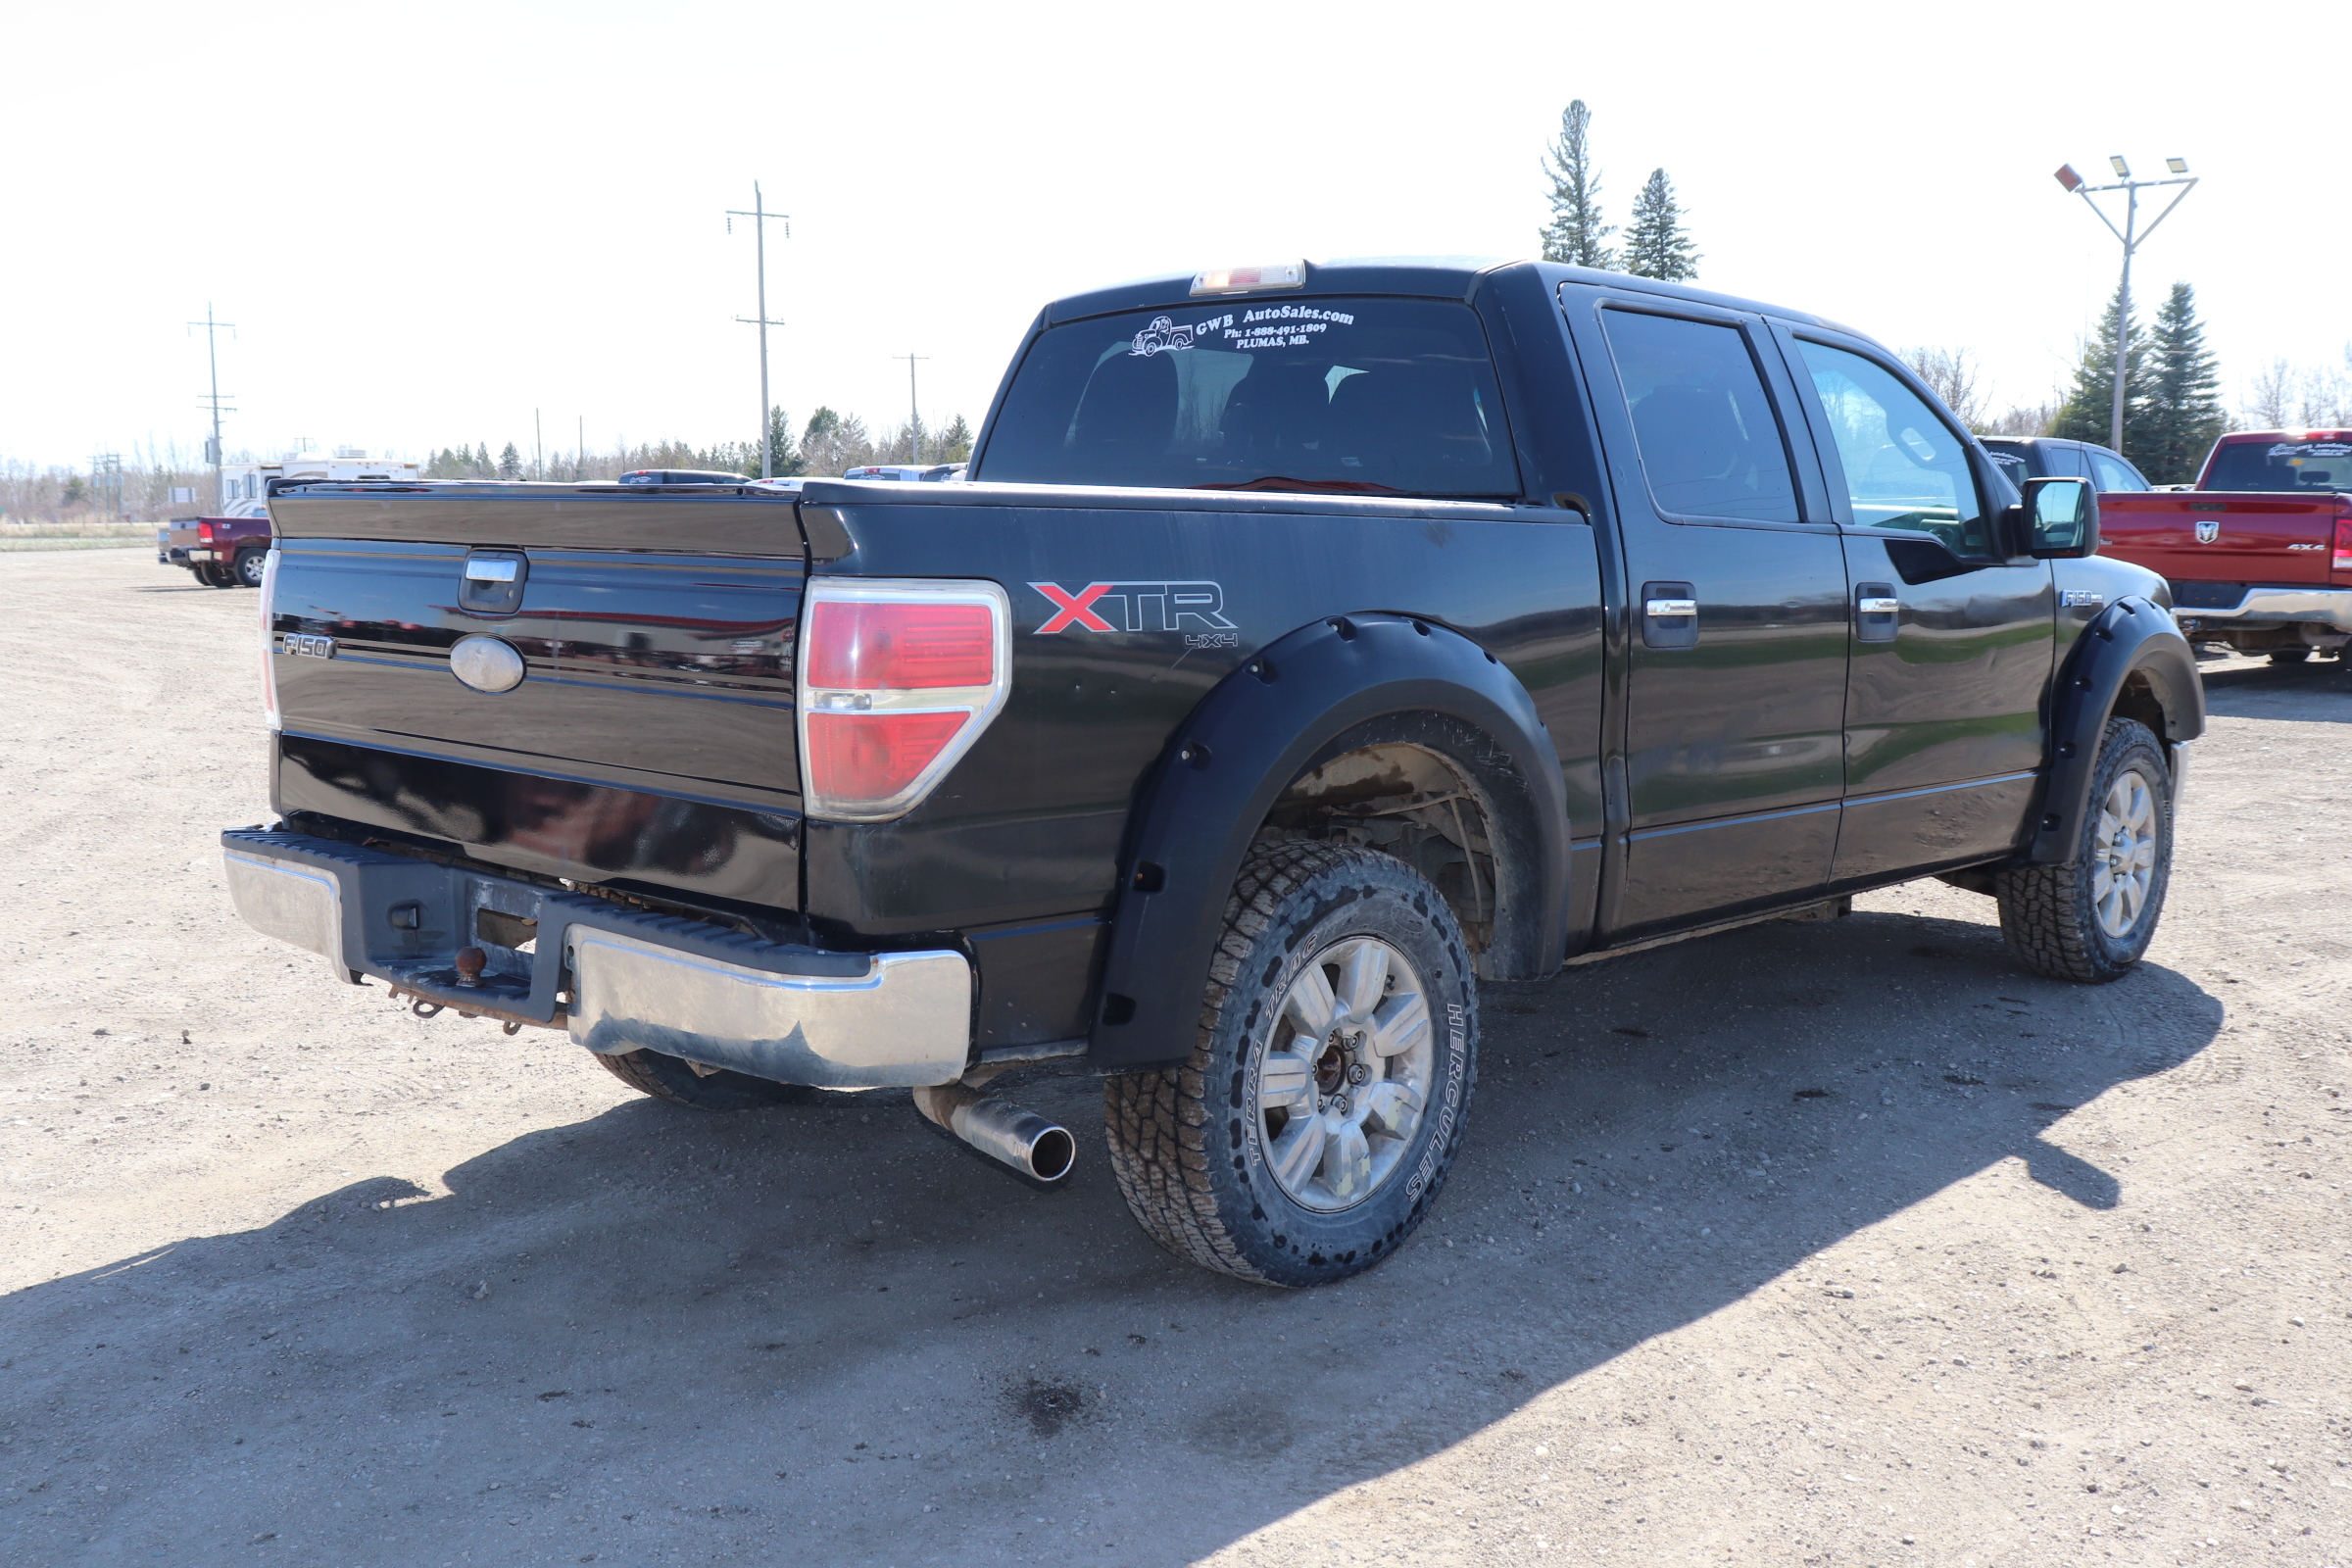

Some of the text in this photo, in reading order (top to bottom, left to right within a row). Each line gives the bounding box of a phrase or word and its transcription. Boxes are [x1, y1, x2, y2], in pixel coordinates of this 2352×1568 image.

[1196, 306, 1354, 336] GWB AutoSales.com
[1224, 323, 1327, 339] Ph: 1-888-491-1809
[1236, 335, 1310, 349] PLUMAS, MB.
[1026, 581, 1239, 634] XTR
[1247, 934, 1317, 1166] TERRA TRAC
[1405, 1004, 1465, 1201] HERCULES
